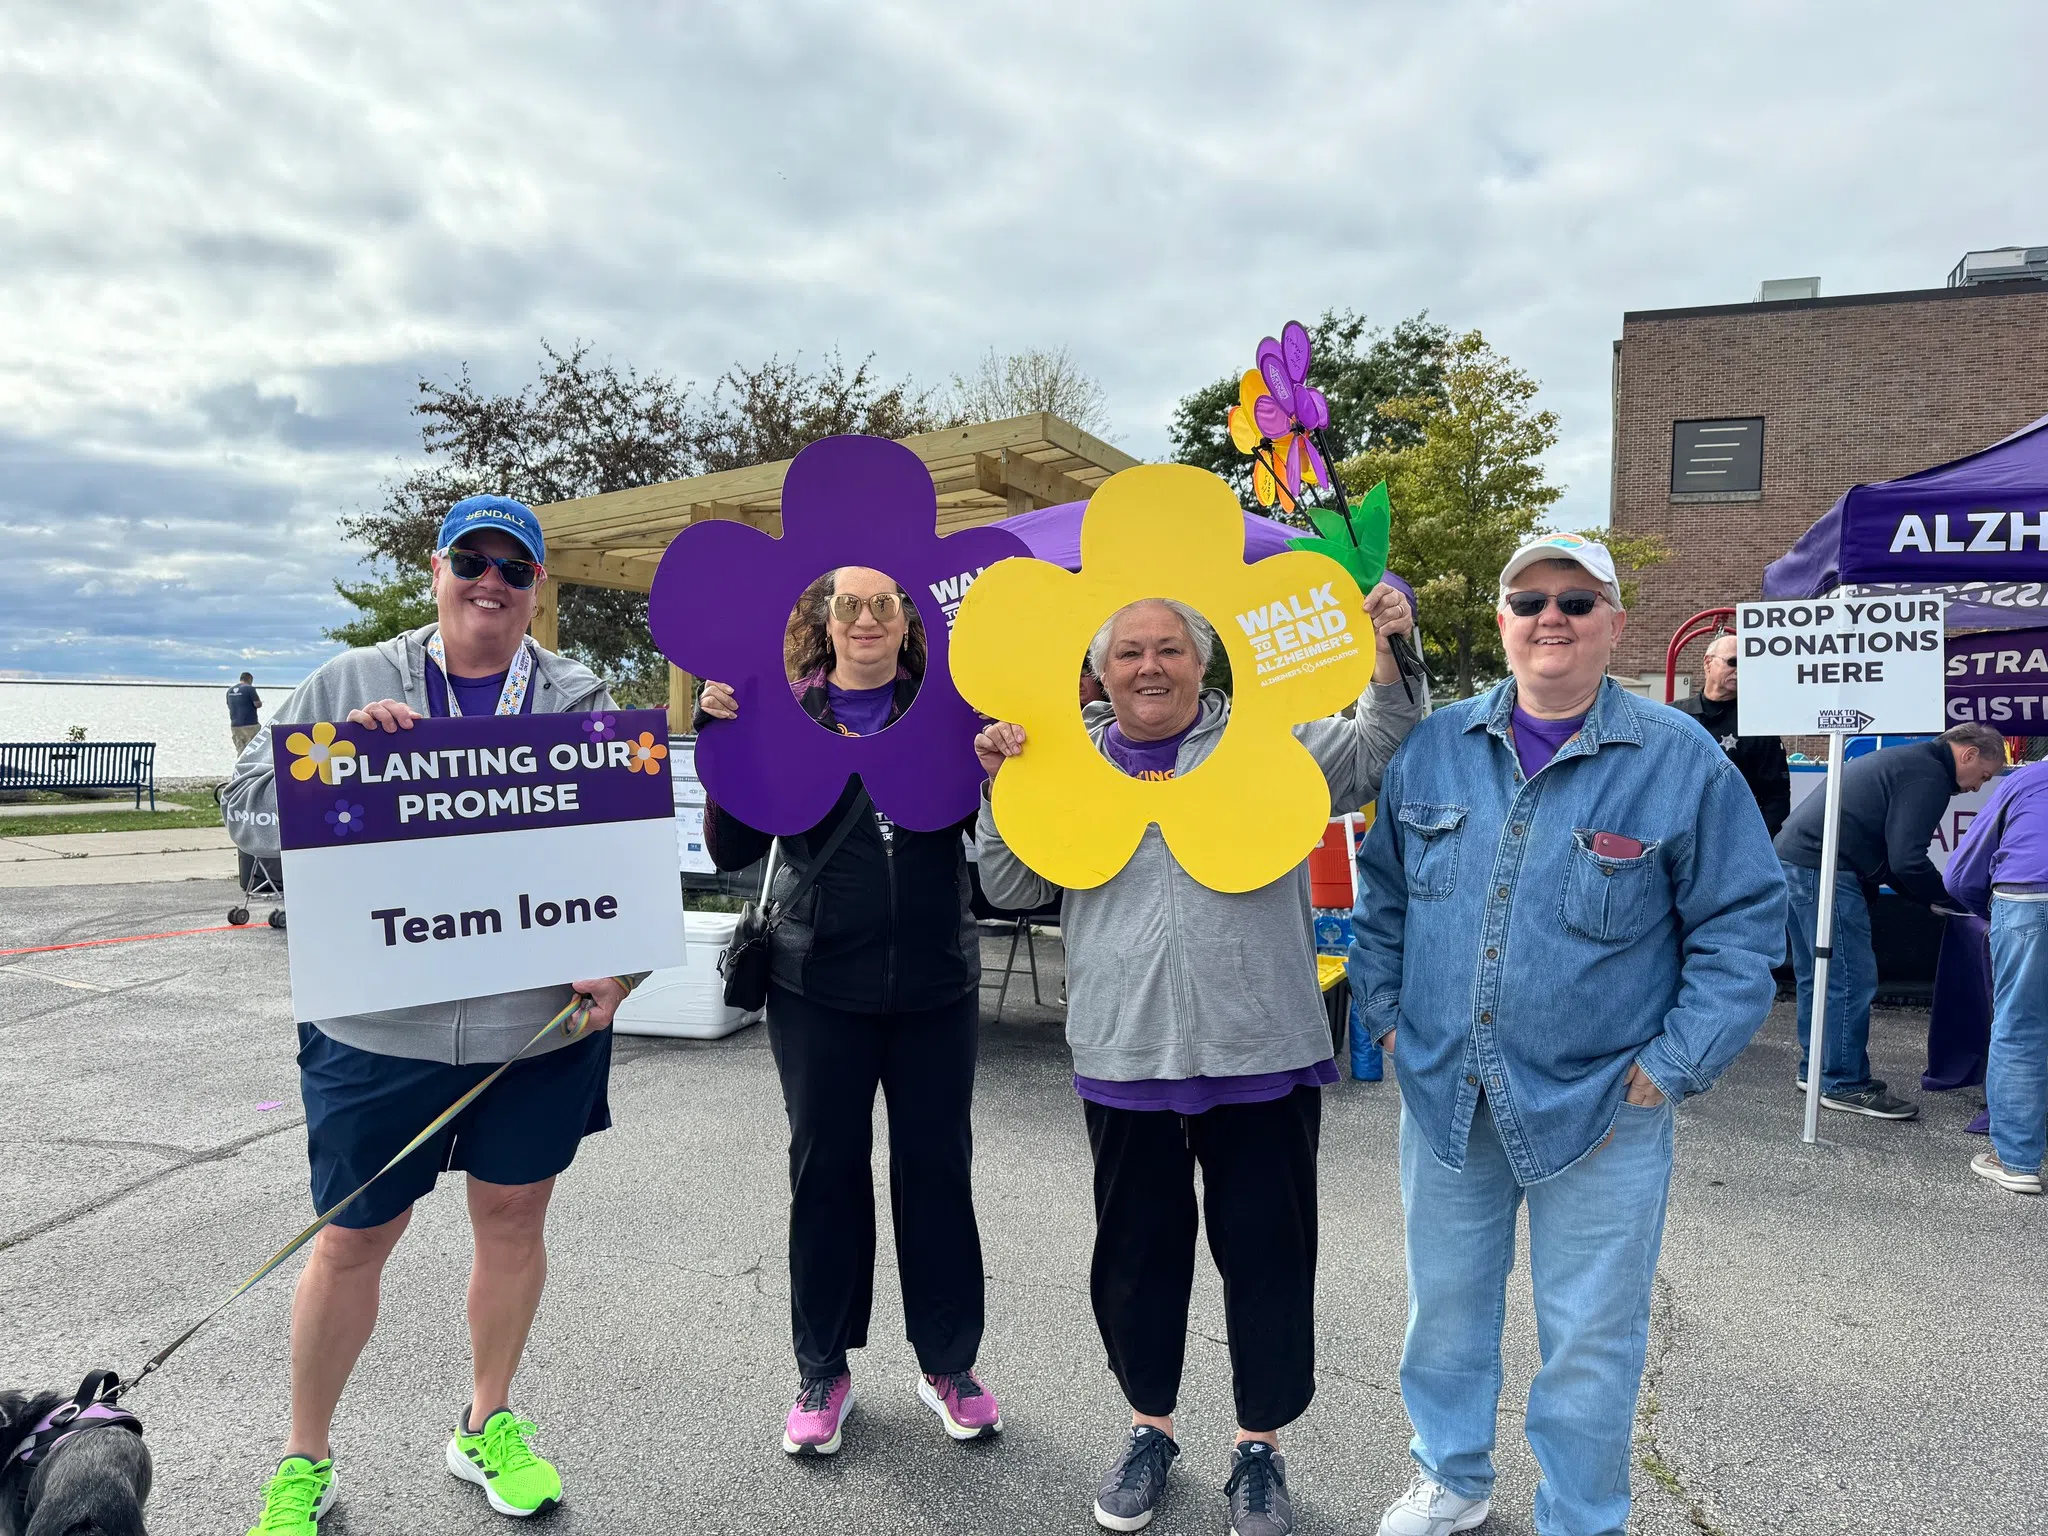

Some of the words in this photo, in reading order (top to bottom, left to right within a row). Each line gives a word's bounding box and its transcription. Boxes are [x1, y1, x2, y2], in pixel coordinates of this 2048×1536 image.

[464, 509, 526, 529] #ENDALZ
[1889, 512, 2048, 553] ALZH
[1235, 582, 1340, 635] WALK
[1743, 605, 1835, 629] DROP
[1844, 600, 1940, 625] YOUR
[1253, 641, 1272, 653] TO
[1274, 609, 1346, 652] END
[1745, 629, 1939, 658] DONATIONS
[1256, 632, 1353, 675] ALZHEIMER'S
[1261, 668, 1302, 687] ALZHEIMER'S
[1315, 648, 1358, 668] ASSOCIATION
[1797, 661, 1884, 684] HERE
[1683, 677, 1689, 685] 8
[1946, 696, 2048, 721] GIST
[330, 746, 537, 785] PLANTING
[548, 741, 632, 771] OUR
[398, 783, 580, 823] PROMISE
[371, 907, 502, 946] Team
[518, 894, 618, 930] Ione
